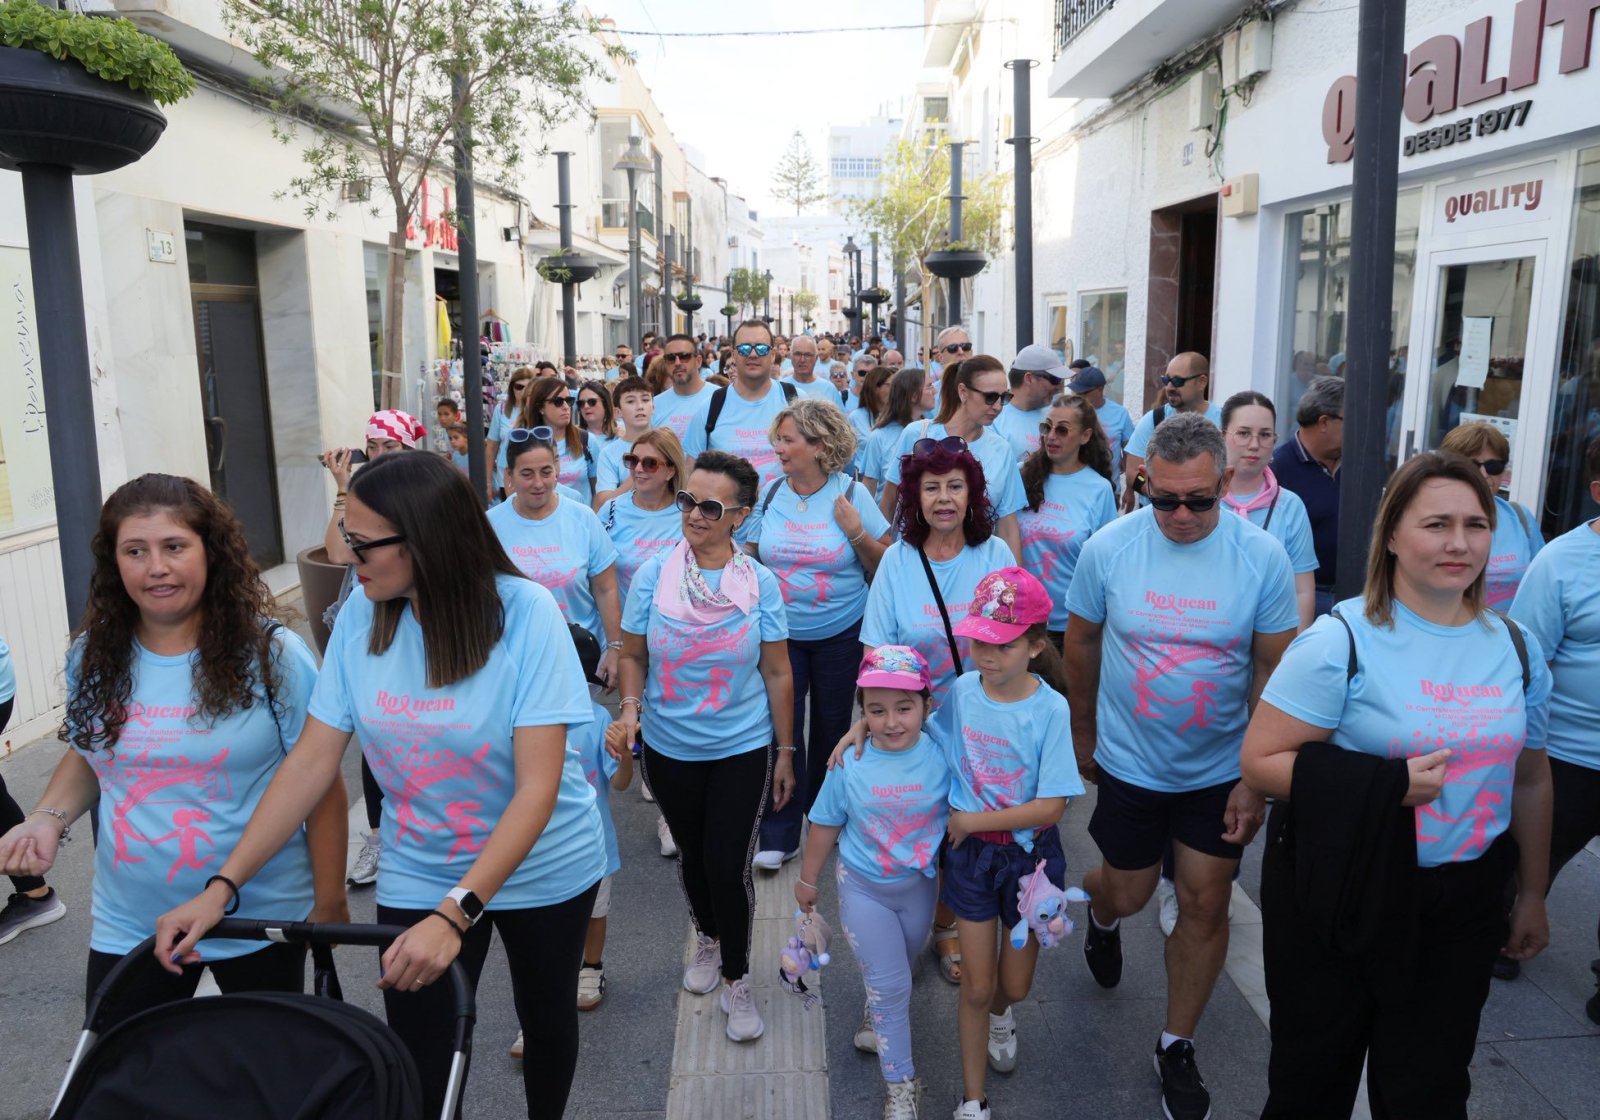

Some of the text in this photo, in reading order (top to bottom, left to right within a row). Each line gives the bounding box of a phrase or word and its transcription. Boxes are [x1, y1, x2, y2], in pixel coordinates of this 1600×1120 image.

[1403, 100, 1533, 156] DESDE 1977
[160, 240, 172, 255] 13
